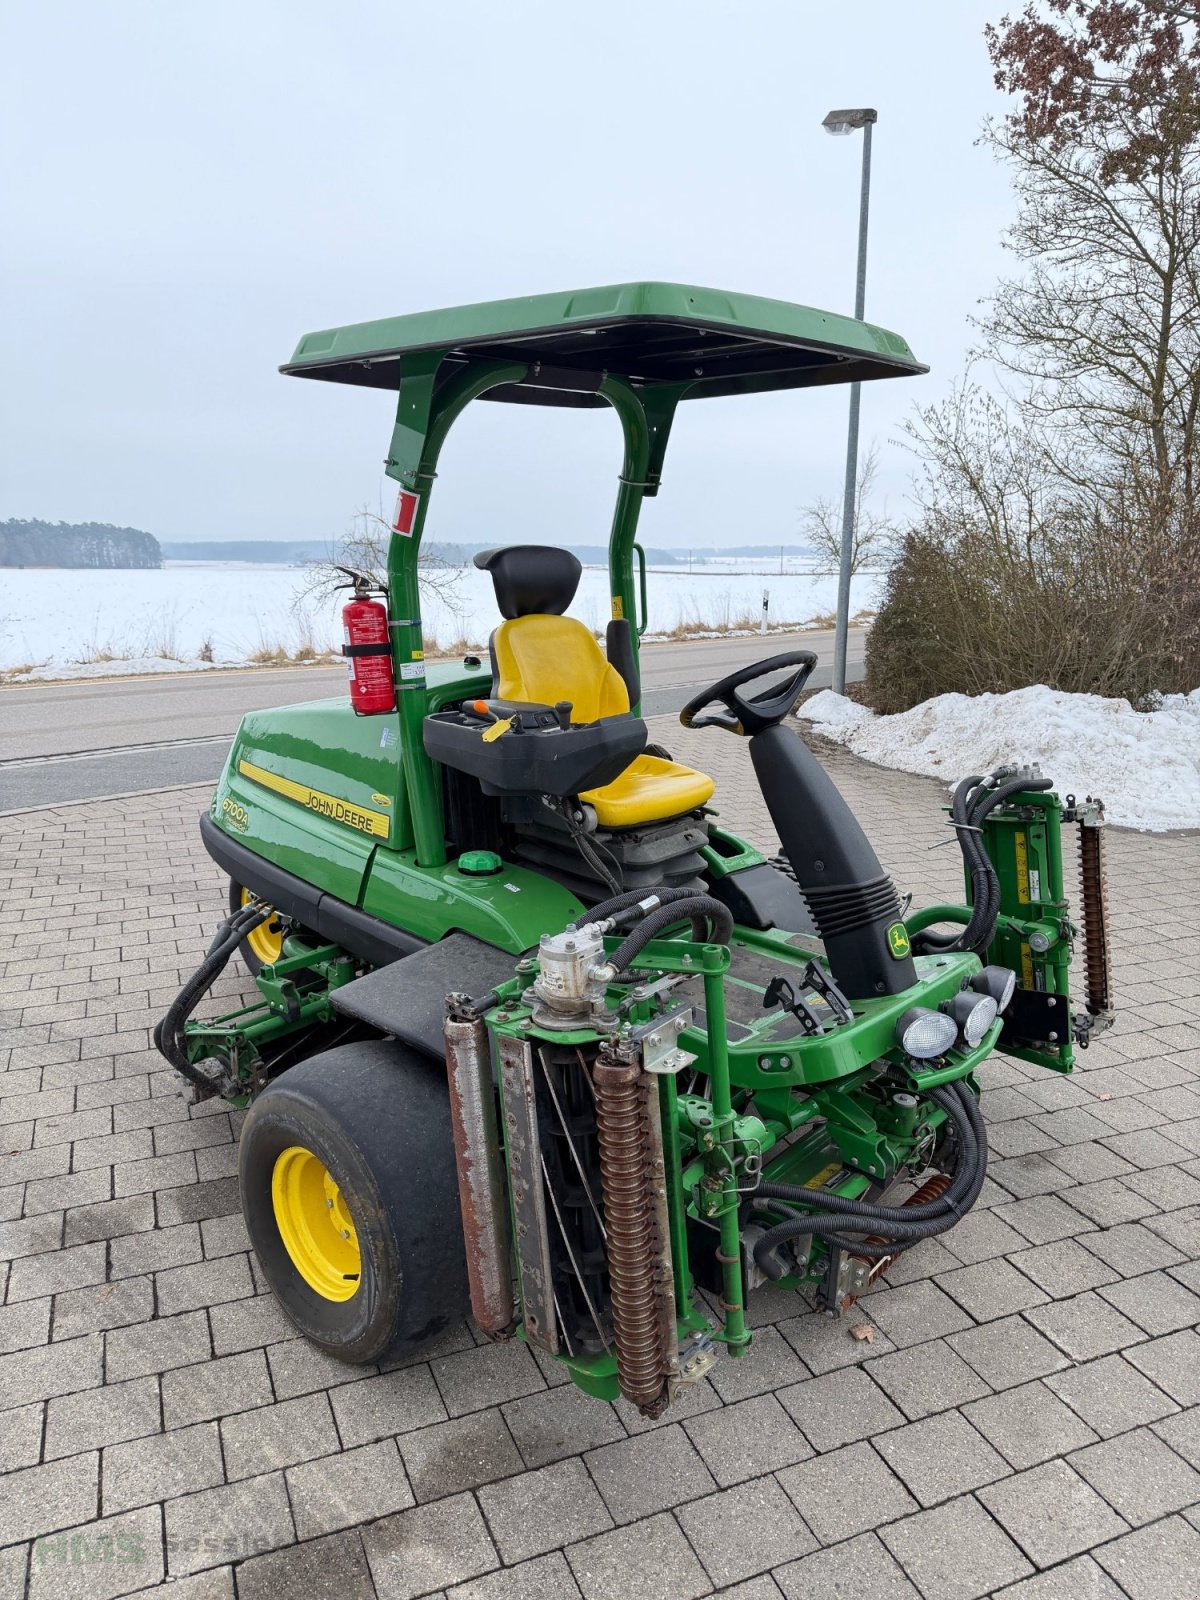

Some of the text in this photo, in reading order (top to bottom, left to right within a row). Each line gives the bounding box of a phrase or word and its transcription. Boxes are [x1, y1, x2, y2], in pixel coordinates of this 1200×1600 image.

[222, 797, 249, 825] 6700A
[305, 791, 374, 832] JOHN DEERE
